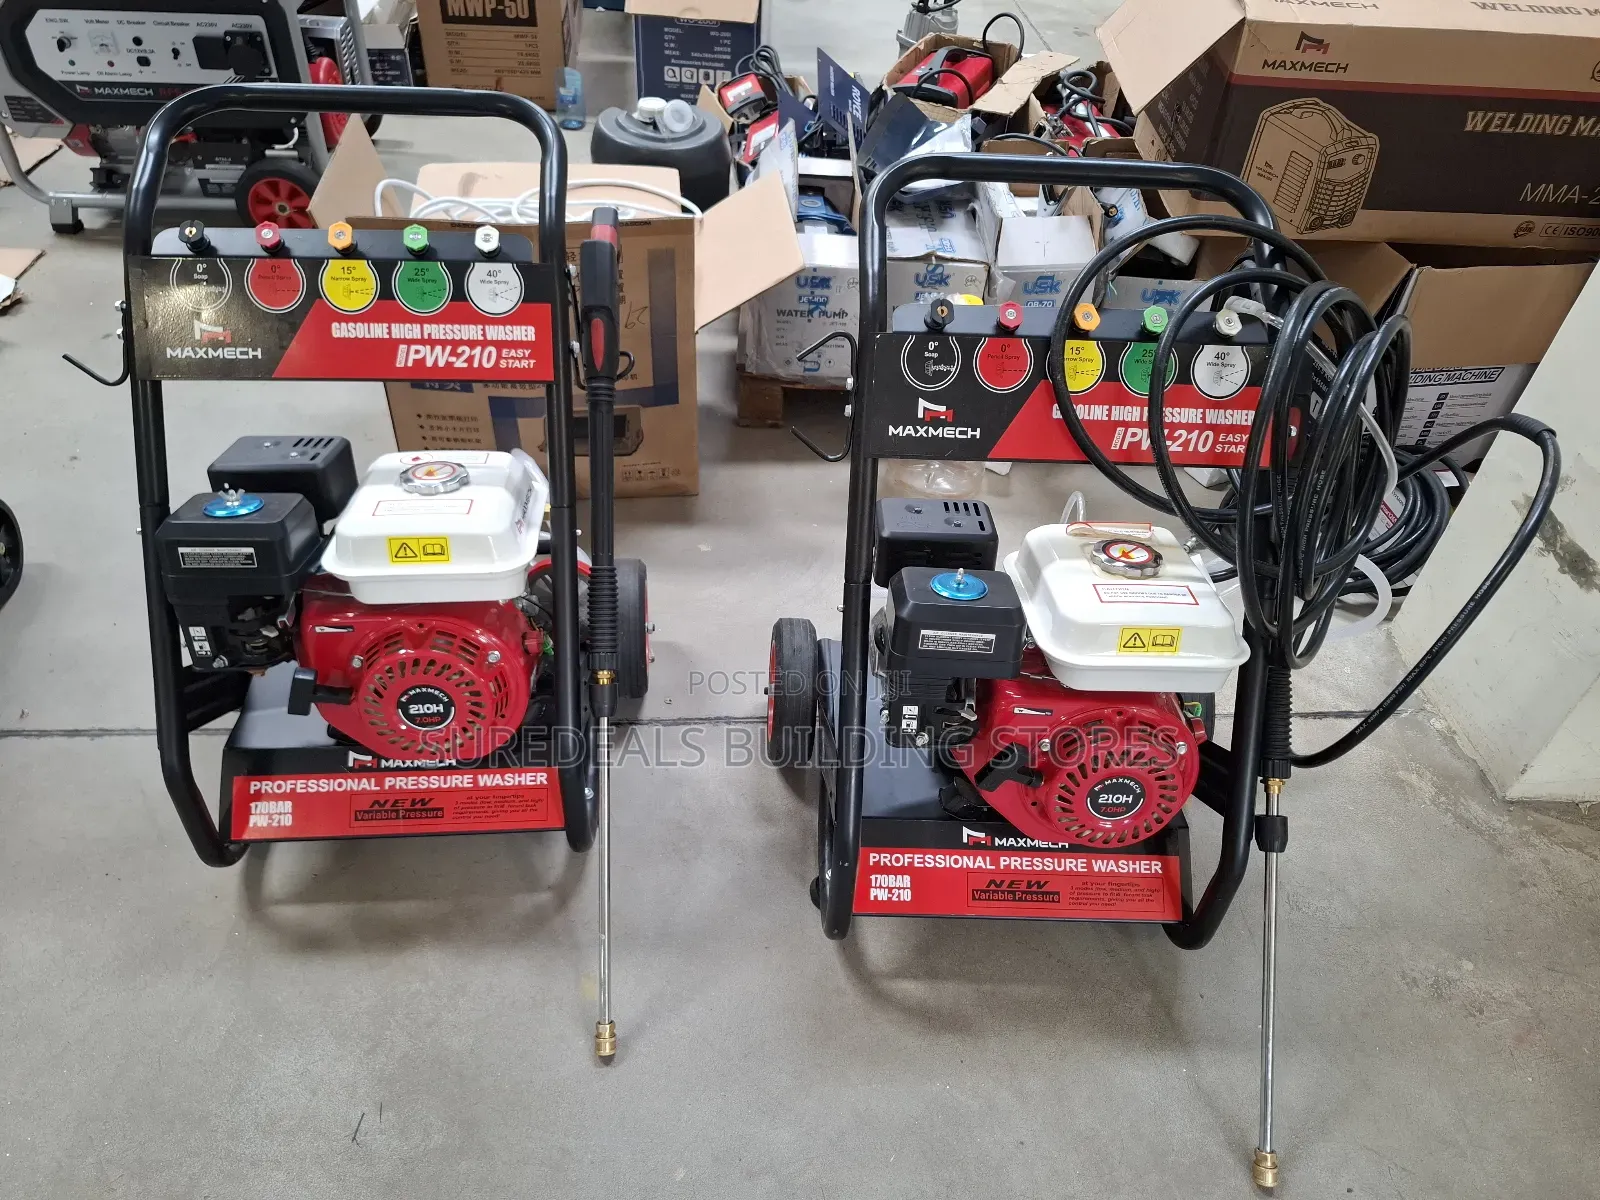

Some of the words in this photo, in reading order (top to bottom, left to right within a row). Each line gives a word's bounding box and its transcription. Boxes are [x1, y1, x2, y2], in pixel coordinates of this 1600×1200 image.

[1470, 1, 1581, 15] WELDING
[1262, 59, 1349, 74] MAXMECH
[95, 87, 154, 96] MAXMECH
[1464, 110, 1570, 135] WELDING
[196, 263, 207, 272] 0°
[270, 264, 281, 273] 0°
[340, 266, 356, 275] 15°
[414, 267, 429, 276] 25°
[486, 269, 501, 278] 40°
[776, 308, 814, 318] WATER
[818, 307, 848, 320] PUMP
[331, 322, 389, 339] GASOLINE
[391, 324, 421, 340] HIGH
[423, 325, 484, 341] PRESSURE
[485, 326, 536, 342] WASHER
[928, 341, 939, 350] 0°
[1000, 343, 1011, 352] 0°
[1069, 346, 1085, 355] 15°
[167, 347, 262, 359] MAXMECH
[407, 345, 497, 369] PW-210
[501, 349, 531, 358] EASY
[1213, 351, 1231, 361] 40°
[499, 359, 536, 369] START
[1443, 371, 1499, 382] MACHINE
[1111, 405, 1140, 422] HIGH
[889, 425, 981, 439] MAXMECH
[1218, 433, 1249, 443] EASY
[1448, 601, 1476, 635] PRESSURE
[1474, 580, 1491, 600] HOSE
[409, 687, 449, 703] MAXMECH
[409, 704, 444, 714] 210H
[415, 716, 442, 724] 7.0HP
[249, 778, 380, 794] PROFESSIONAL
[384, 775, 474, 789] PRESSURE
[477, 773, 548, 787] WASHER
[1104, 777, 1142, 794] MAXMECH
[369, 798, 436, 808] NEW
[1098, 794, 1133, 804] 210H
[250, 801, 293, 814] 170BAR
[249, 814, 293, 827] PW-210
[356, 810, 397, 821] Variable
[400, 809, 443, 818] Pressure
[869, 853, 995, 869] PROFESSIONAL
[1000, 855, 1087, 872] PRESSURE
[1092, 859, 1163, 874] WASHER
[869, 874, 911, 888] 170BAR
[985, 879, 1050, 889] NEW
[869, 888, 912, 902] PW-210
[974, 890, 1013, 900] Variable
[1015, 891, 1060, 902] Pressure
